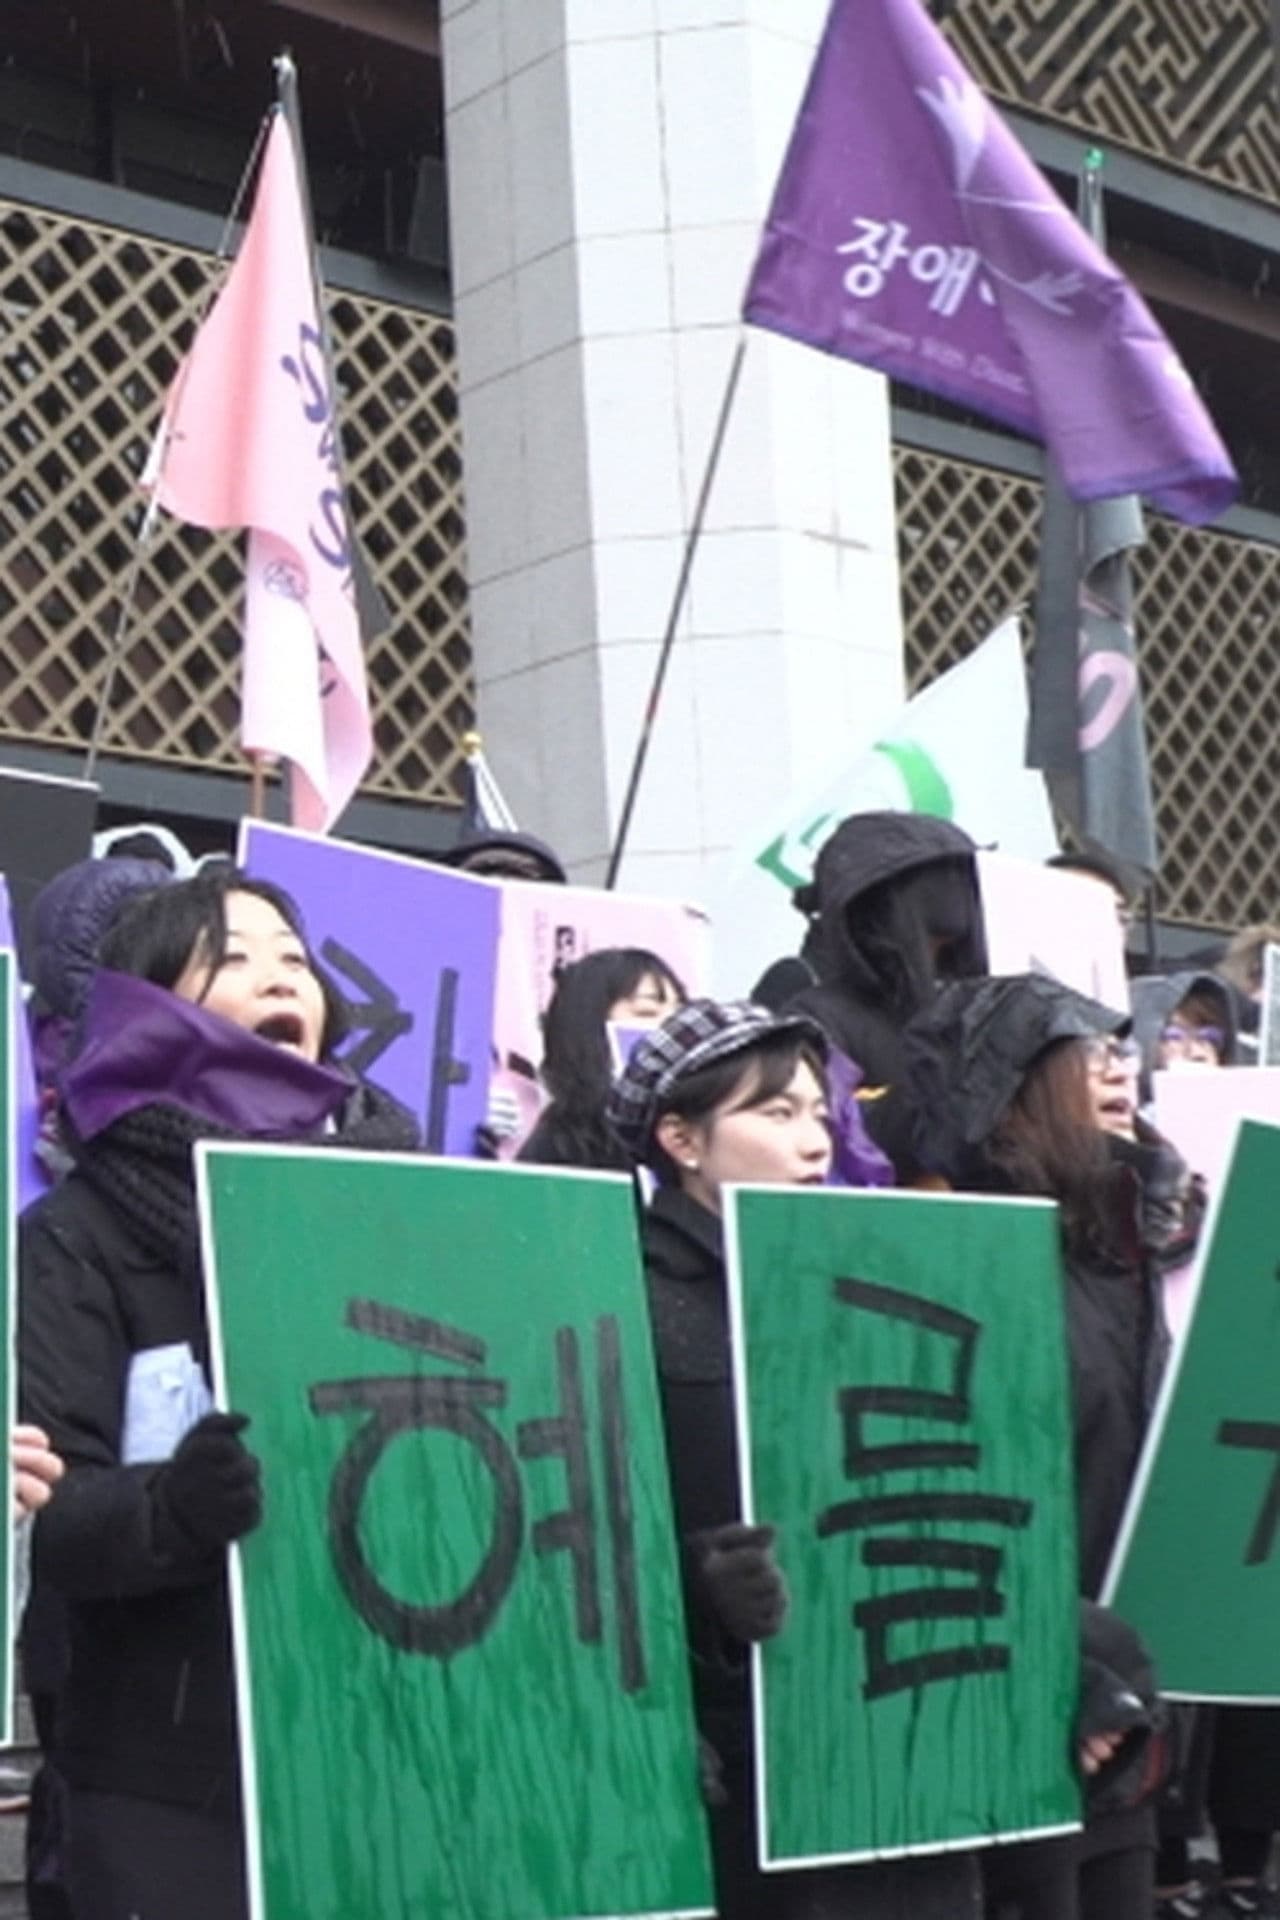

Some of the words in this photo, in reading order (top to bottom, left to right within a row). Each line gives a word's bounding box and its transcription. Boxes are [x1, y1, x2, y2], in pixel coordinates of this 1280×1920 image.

[836, 216, 996, 317] 장애
[308, 1297, 648, 1694] 혜
[815, 1276, 1033, 1701] 름
